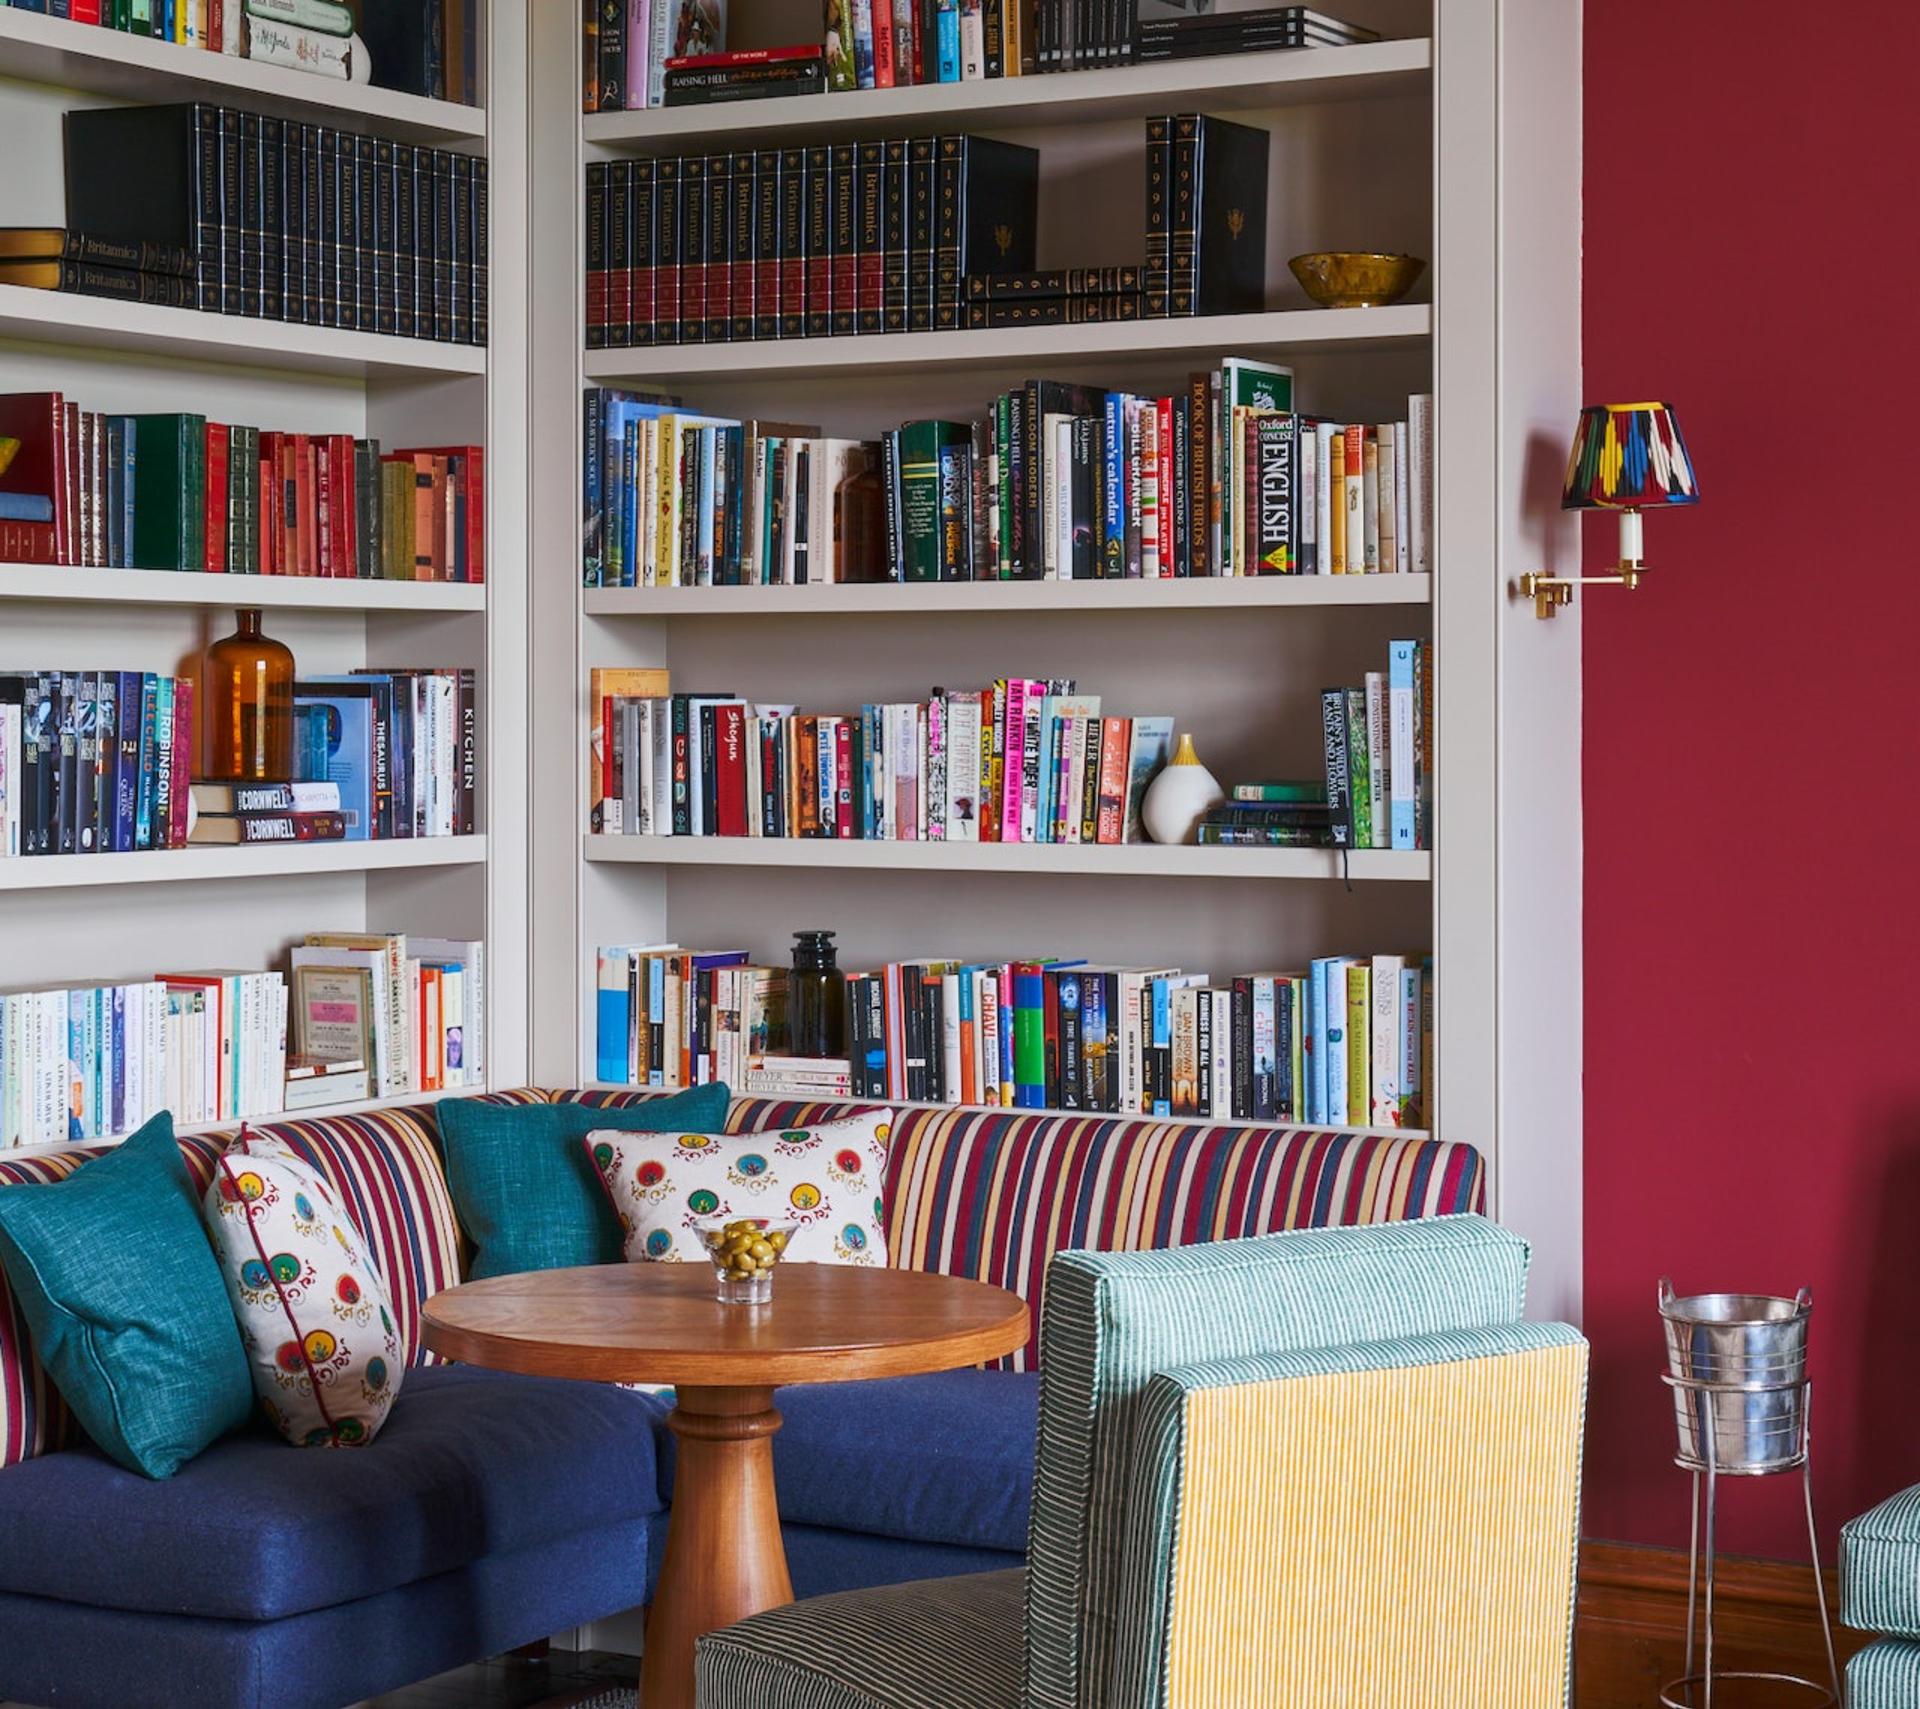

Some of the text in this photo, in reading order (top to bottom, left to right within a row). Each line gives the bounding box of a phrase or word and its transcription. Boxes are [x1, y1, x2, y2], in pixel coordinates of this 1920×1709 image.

[750, 50, 768, 59] WORLD
[881, 27, 889, 41] Red
[672, 73, 728, 87] RAISING HELL
[342, 165, 353, 236] Britannica
[380, 172, 390, 242] Britannica
[865, 172, 877, 244] Britannica
[917, 171, 925, 240] 1988
[943, 168, 952, 238] 1994
[1152, 153, 1160, 224] 1990
[1180, 150, 1188, 222] 1991
[591, 194, 602, 262] Britannica
[614, 192, 625, 260] Britannica
[638, 190, 649, 259] Britannica
[662, 188, 673, 257] Britannica
[688, 187, 699, 255] Britannica
[712, 185, 723, 254] Britannica
[738, 183, 749, 252] Britannica
[762, 181, 773, 250] Britannica
[787, 179, 797, 249] Britannica
[814, 177, 824, 247] Britannica
[839, 175, 849, 245] Britannica
[87, 240, 138, 260] Britannica
[85, 271, 136, 289] Britannica
[996, 278, 1059, 289] 1992
[995, 307, 1058, 319] 1993
[588, 418, 597, 464] MAVERICK
[1011, 398, 1021, 439] RAISING
[1161, 412, 1169, 429] THE
[1260, 419, 1293, 430] Oxford
[1011, 441, 1021, 466] HELL
[1028, 388, 1037, 508] HEIRLOOM MODERN
[1107, 402, 1119, 525] nature's calendar
[1193, 383, 1205, 546] BOOK OF BRITISH BIRDS
[942, 455, 954, 501] DEADLY
[1132, 456, 1141, 527] GRANGER
[1161, 457, 1169, 504] PRINCIPLE
[1176, 479, 1184, 490] TO
[1262, 441, 1290, 543] ENGLISH
[1176, 490, 1184, 525] CYCLING
[1160, 521, 1168, 554] SLATER
[146, 694, 155, 721] LEE
[1010, 682, 1021, 703] IAN
[1422, 645, 1432, 774] THE RECORD BREAKERS
[144, 725, 154, 771] CHILD
[464, 708, 473, 789] KITCHEN
[725, 709, 740, 761] Shogun
[1009, 707, 1020, 751] RANKIN
[1073, 720, 1084, 757] HEYER
[1087, 723, 1099, 760] HEYER
[1327, 735, 1336, 759] AND
[1373, 698, 1381, 760] CONSTANTINOPLE
[158, 716, 171, 804] ROBINSON
[376, 720, 386, 790] THESAURUS
[821, 753, 830, 799] TOWNSHEND
[901, 738, 911, 772] Bryson
[982, 730, 990, 782] CYCLING
[1010, 755, 1020, 770] EVEN
[1024, 755, 1040, 788] TIGER
[1087, 763, 1097, 780] The
[1336, 746, 1347, 792] WILDLIFE
[242, 790, 289, 810] CORNWELL
[1009, 797, 1018, 807] THE
[1328, 762, 1340, 810] FLOWERS
[1383, 768, 1391, 792] PETER
[250, 818, 295, 840] CORNWELL
[1007, 809, 1017, 824] WILD
[1101, 804, 1119, 839] KILLING FLOOR
[1067, 1020, 1075, 1039] TIME
[1199, 993, 1209, 1032] FAIRNESS
[1256, 1011, 1265, 1054] CHILD
[114, 1030, 122, 1083] Sea Sisters
[1067, 1041, 1075, 1070] TRAVEL
[1183, 1012, 1193, 1074] DAN BROWN
[1199, 1033, 1209, 1050] FOR
[1199, 1051, 1209, 1066] ALL
[750, 1072, 783, 1081] HEYER
